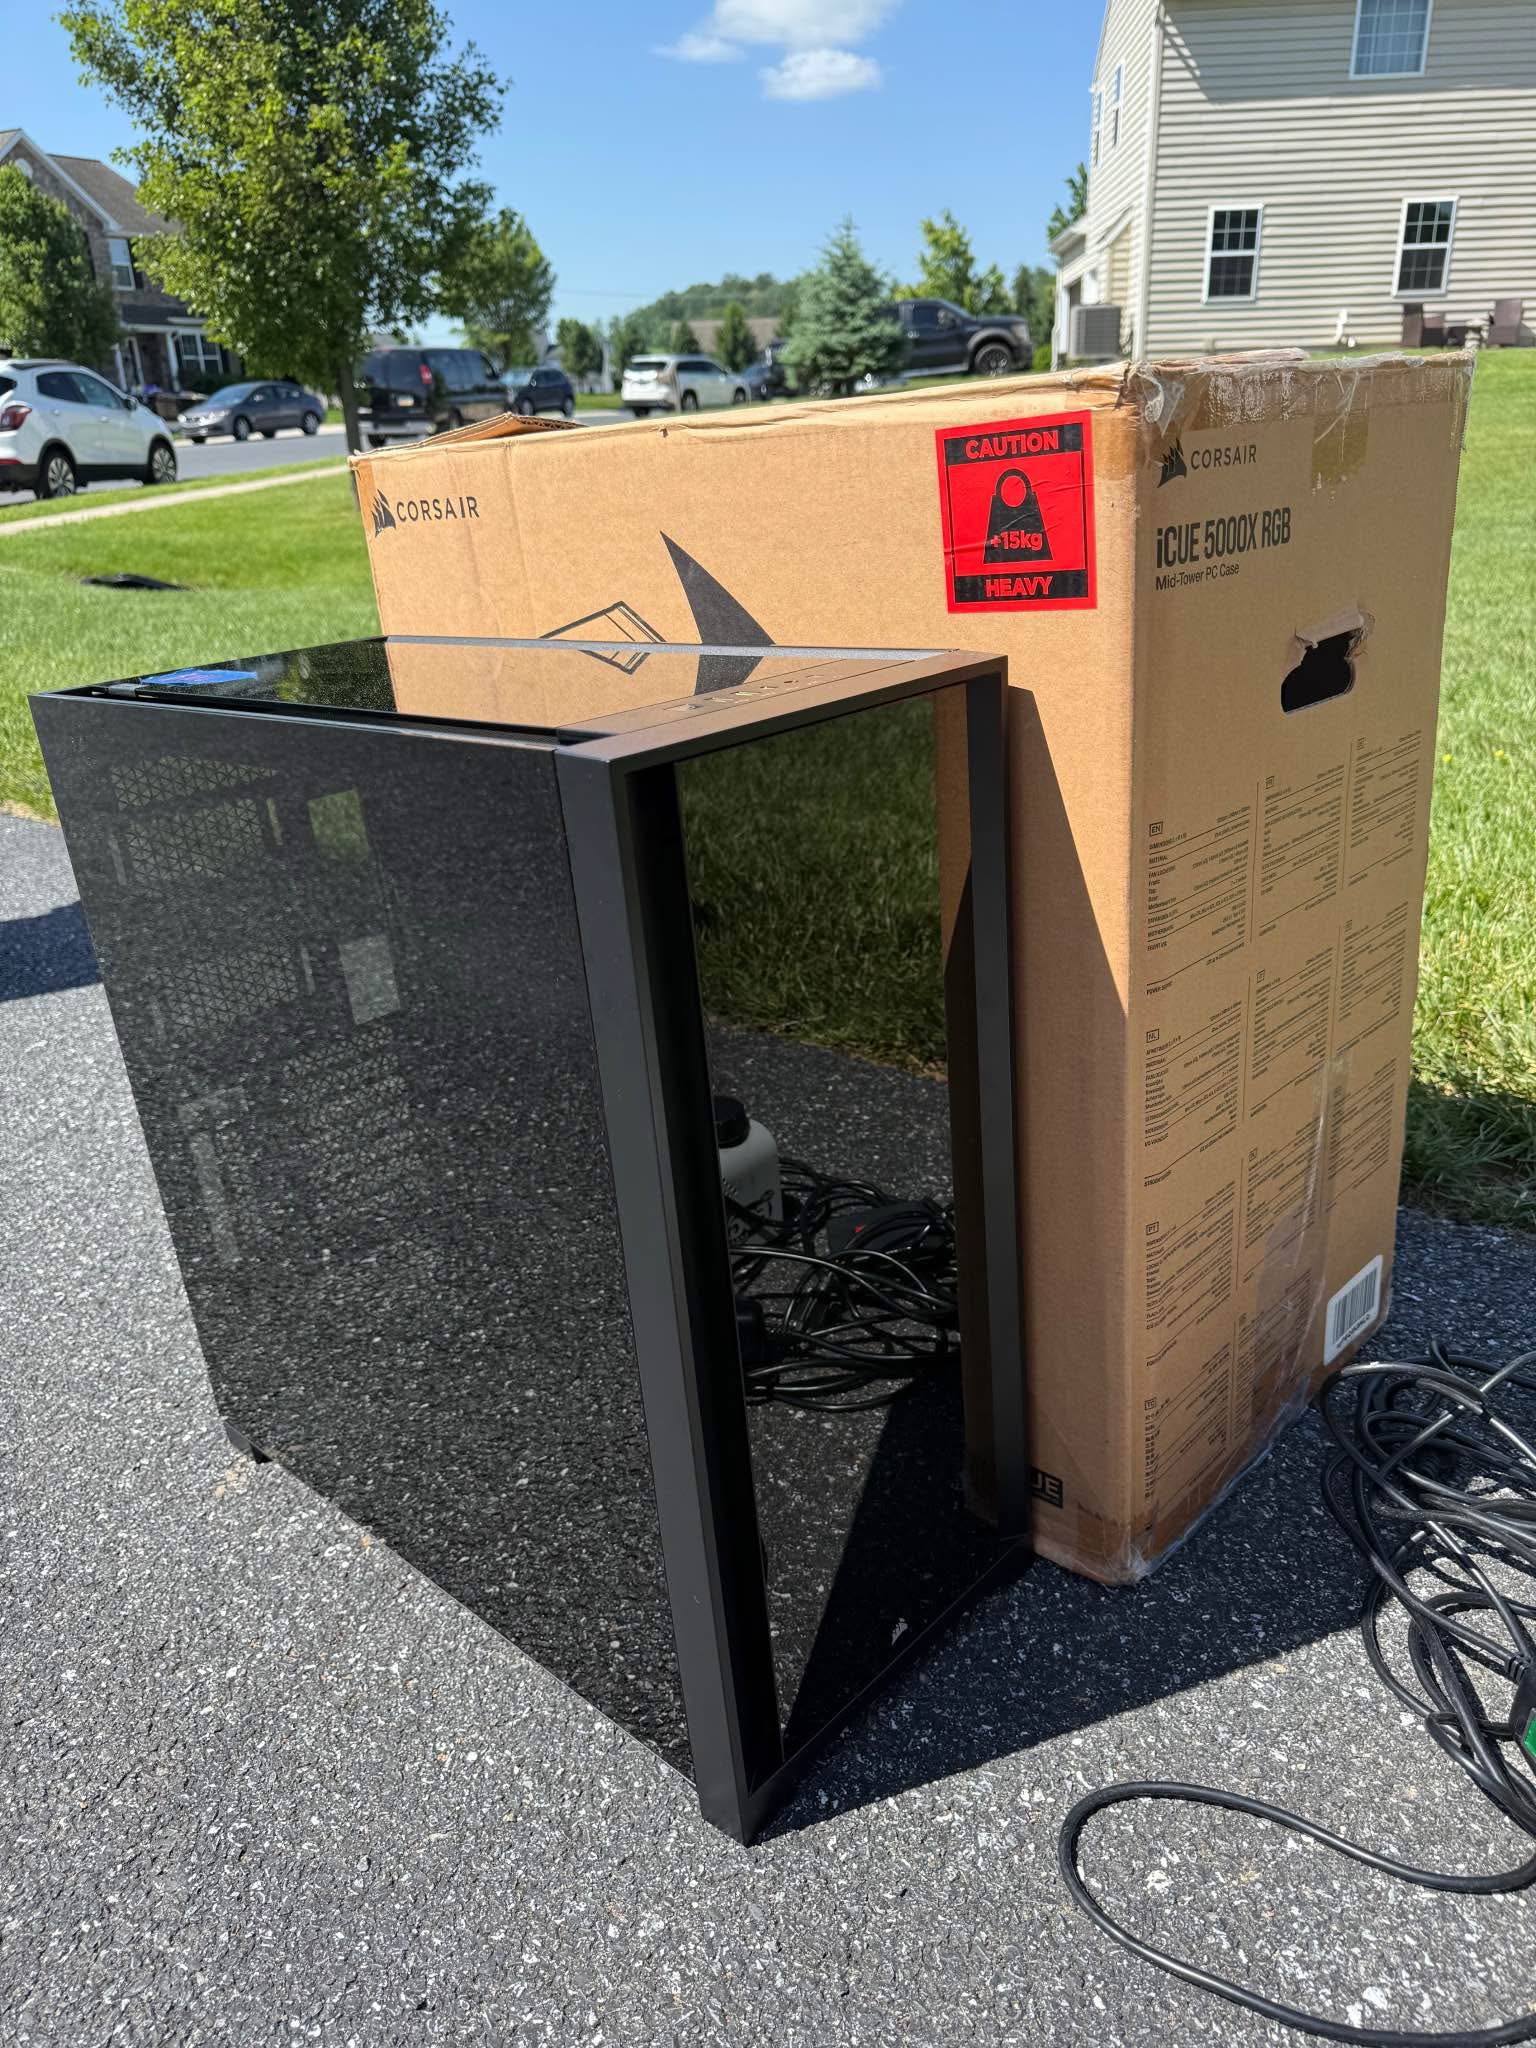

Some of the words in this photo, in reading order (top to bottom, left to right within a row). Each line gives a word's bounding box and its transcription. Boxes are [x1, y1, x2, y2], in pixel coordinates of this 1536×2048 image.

[965, 430, 1059, 459] CAUTION
[1190, 444, 1257, 470] CORSAIR
[396, 496, 480, 522] CORSAIR
[990, 530, 1043, 551] +15kg
[1156, 522, 1201, 569] iCUE
[1204, 511, 1259, 559] 5000X
[1261, 507, 1291, 548] RGB
[985, 576, 1054, 597] HEAVY
[1155, 570, 1204, 591] Mid-Tower
[1205, 564, 1218, 580] PC
[1219, 561, 1240, 577] Case
